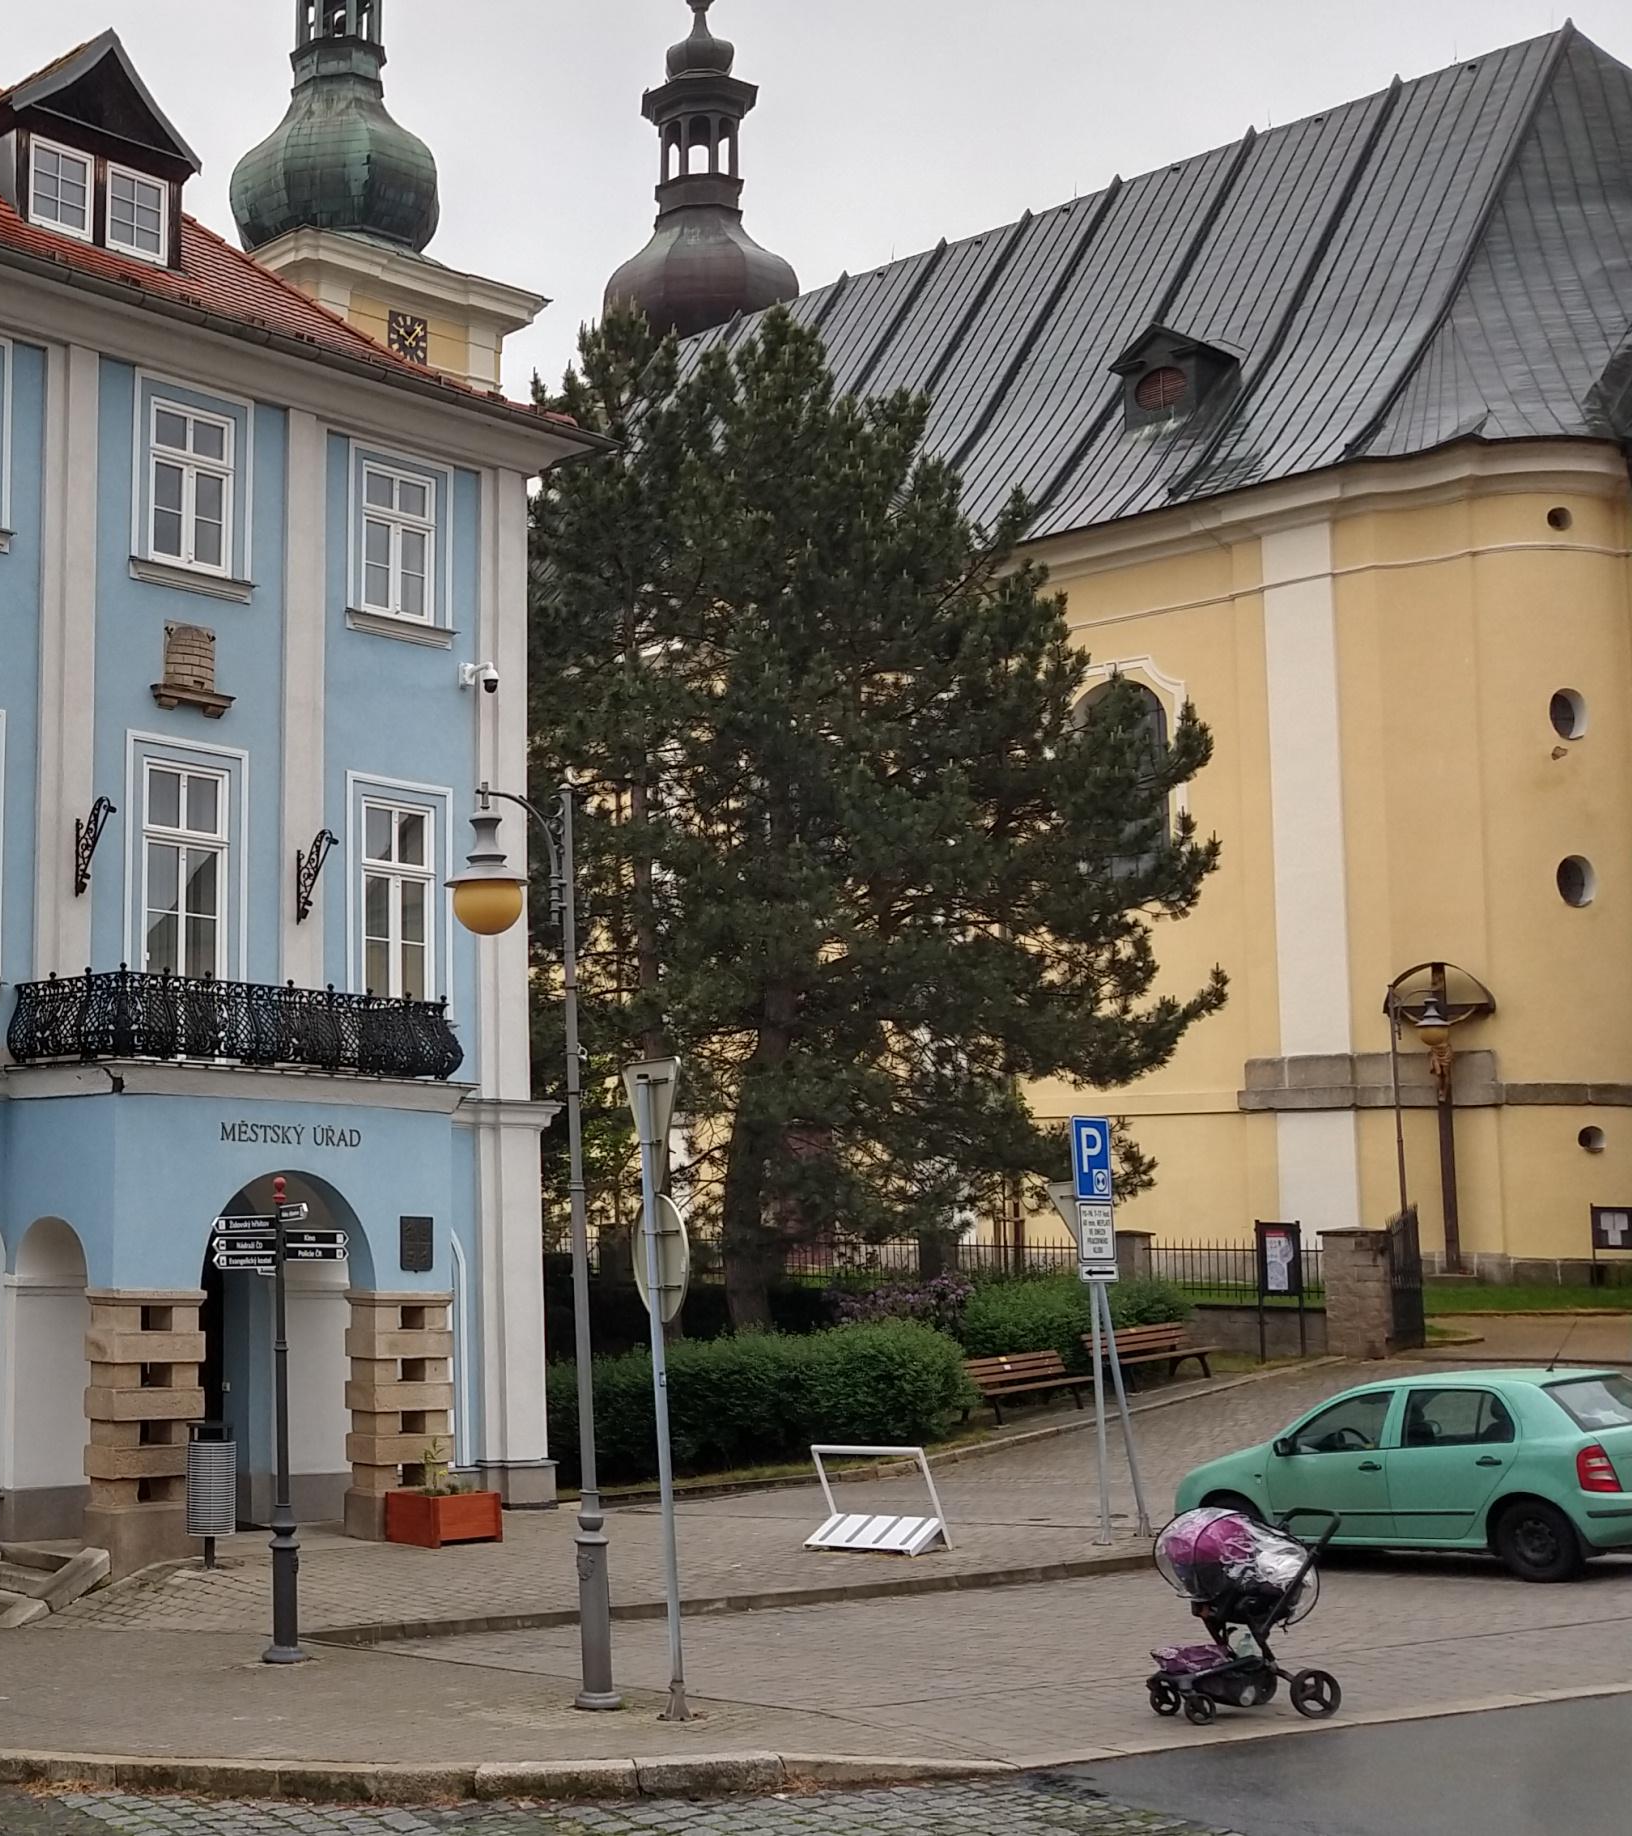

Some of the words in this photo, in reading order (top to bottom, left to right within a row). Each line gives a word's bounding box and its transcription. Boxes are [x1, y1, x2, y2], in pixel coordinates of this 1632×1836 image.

[220, 1120, 305, 1145] MĚSTSKÝ
[313, 1124, 361, 1147] ÚŘAD
[1080, 1127, 1102, 1173] P
[304, 1234, 316, 1242] Kino
[236, 1240, 255, 1249] Nádraží
[298, 1249, 314, 1257] Policie
[315, 1248, 322, 1257] ČR
[229, 1257, 257, 1266] Evangelický
[257, 1256, 272, 1264] kostel
